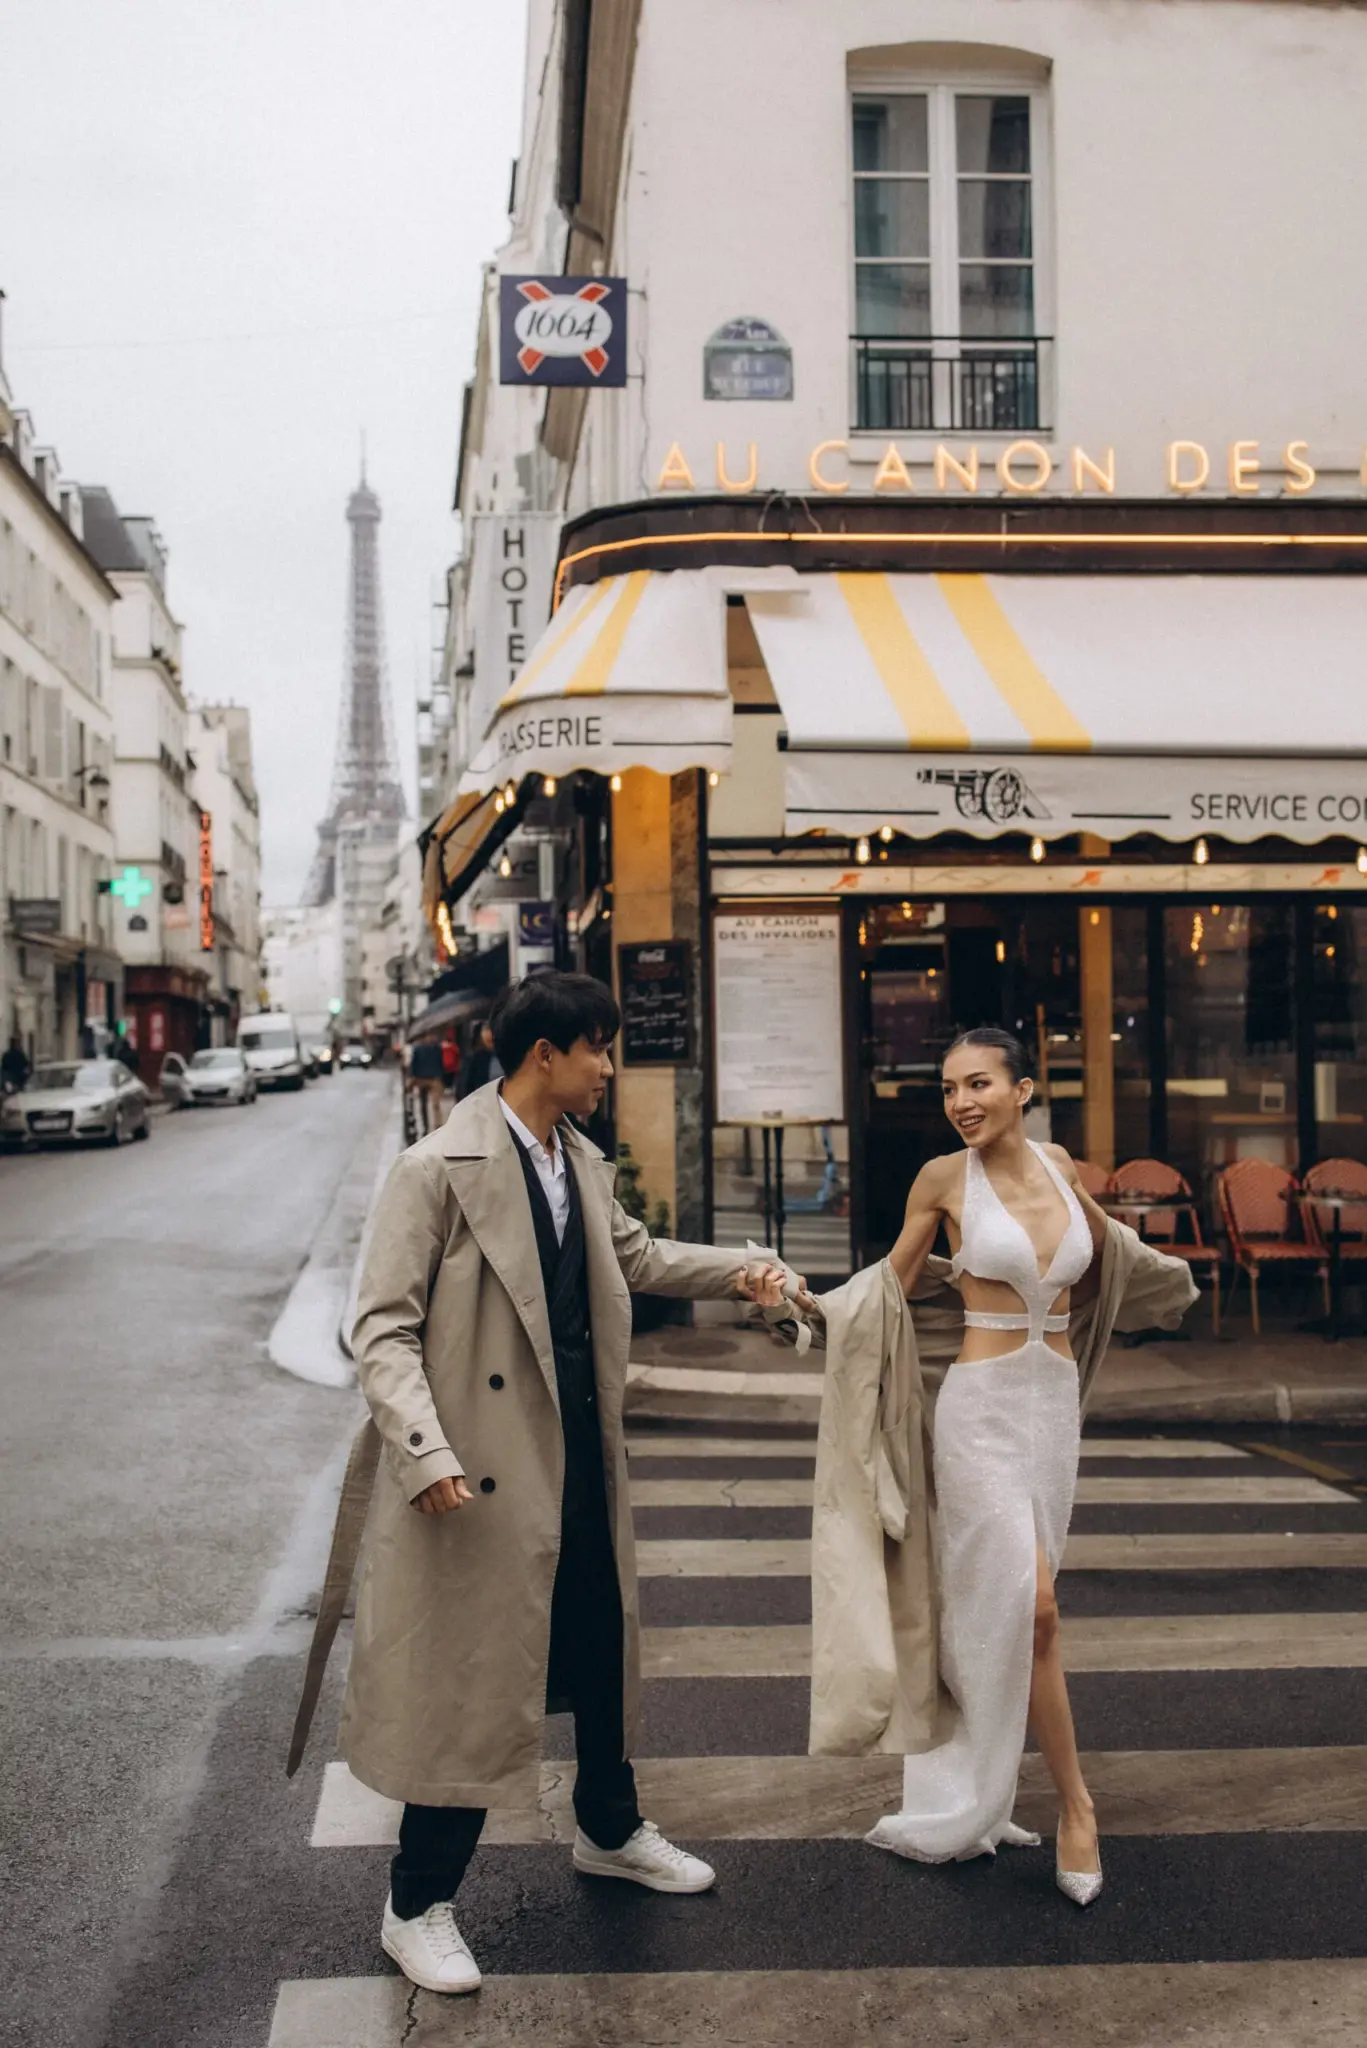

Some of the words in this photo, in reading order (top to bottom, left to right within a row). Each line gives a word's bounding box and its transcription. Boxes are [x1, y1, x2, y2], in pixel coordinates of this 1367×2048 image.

[526, 305, 600, 340] 1664
[657, 440, 758, 493] AU
[808, 439, 1116, 493] CANON
[1168, 439, 1316, 494] DES
[502, 716, 602, 757] ASSERIE
[1190, 793, 1308, 821] SERVICE
